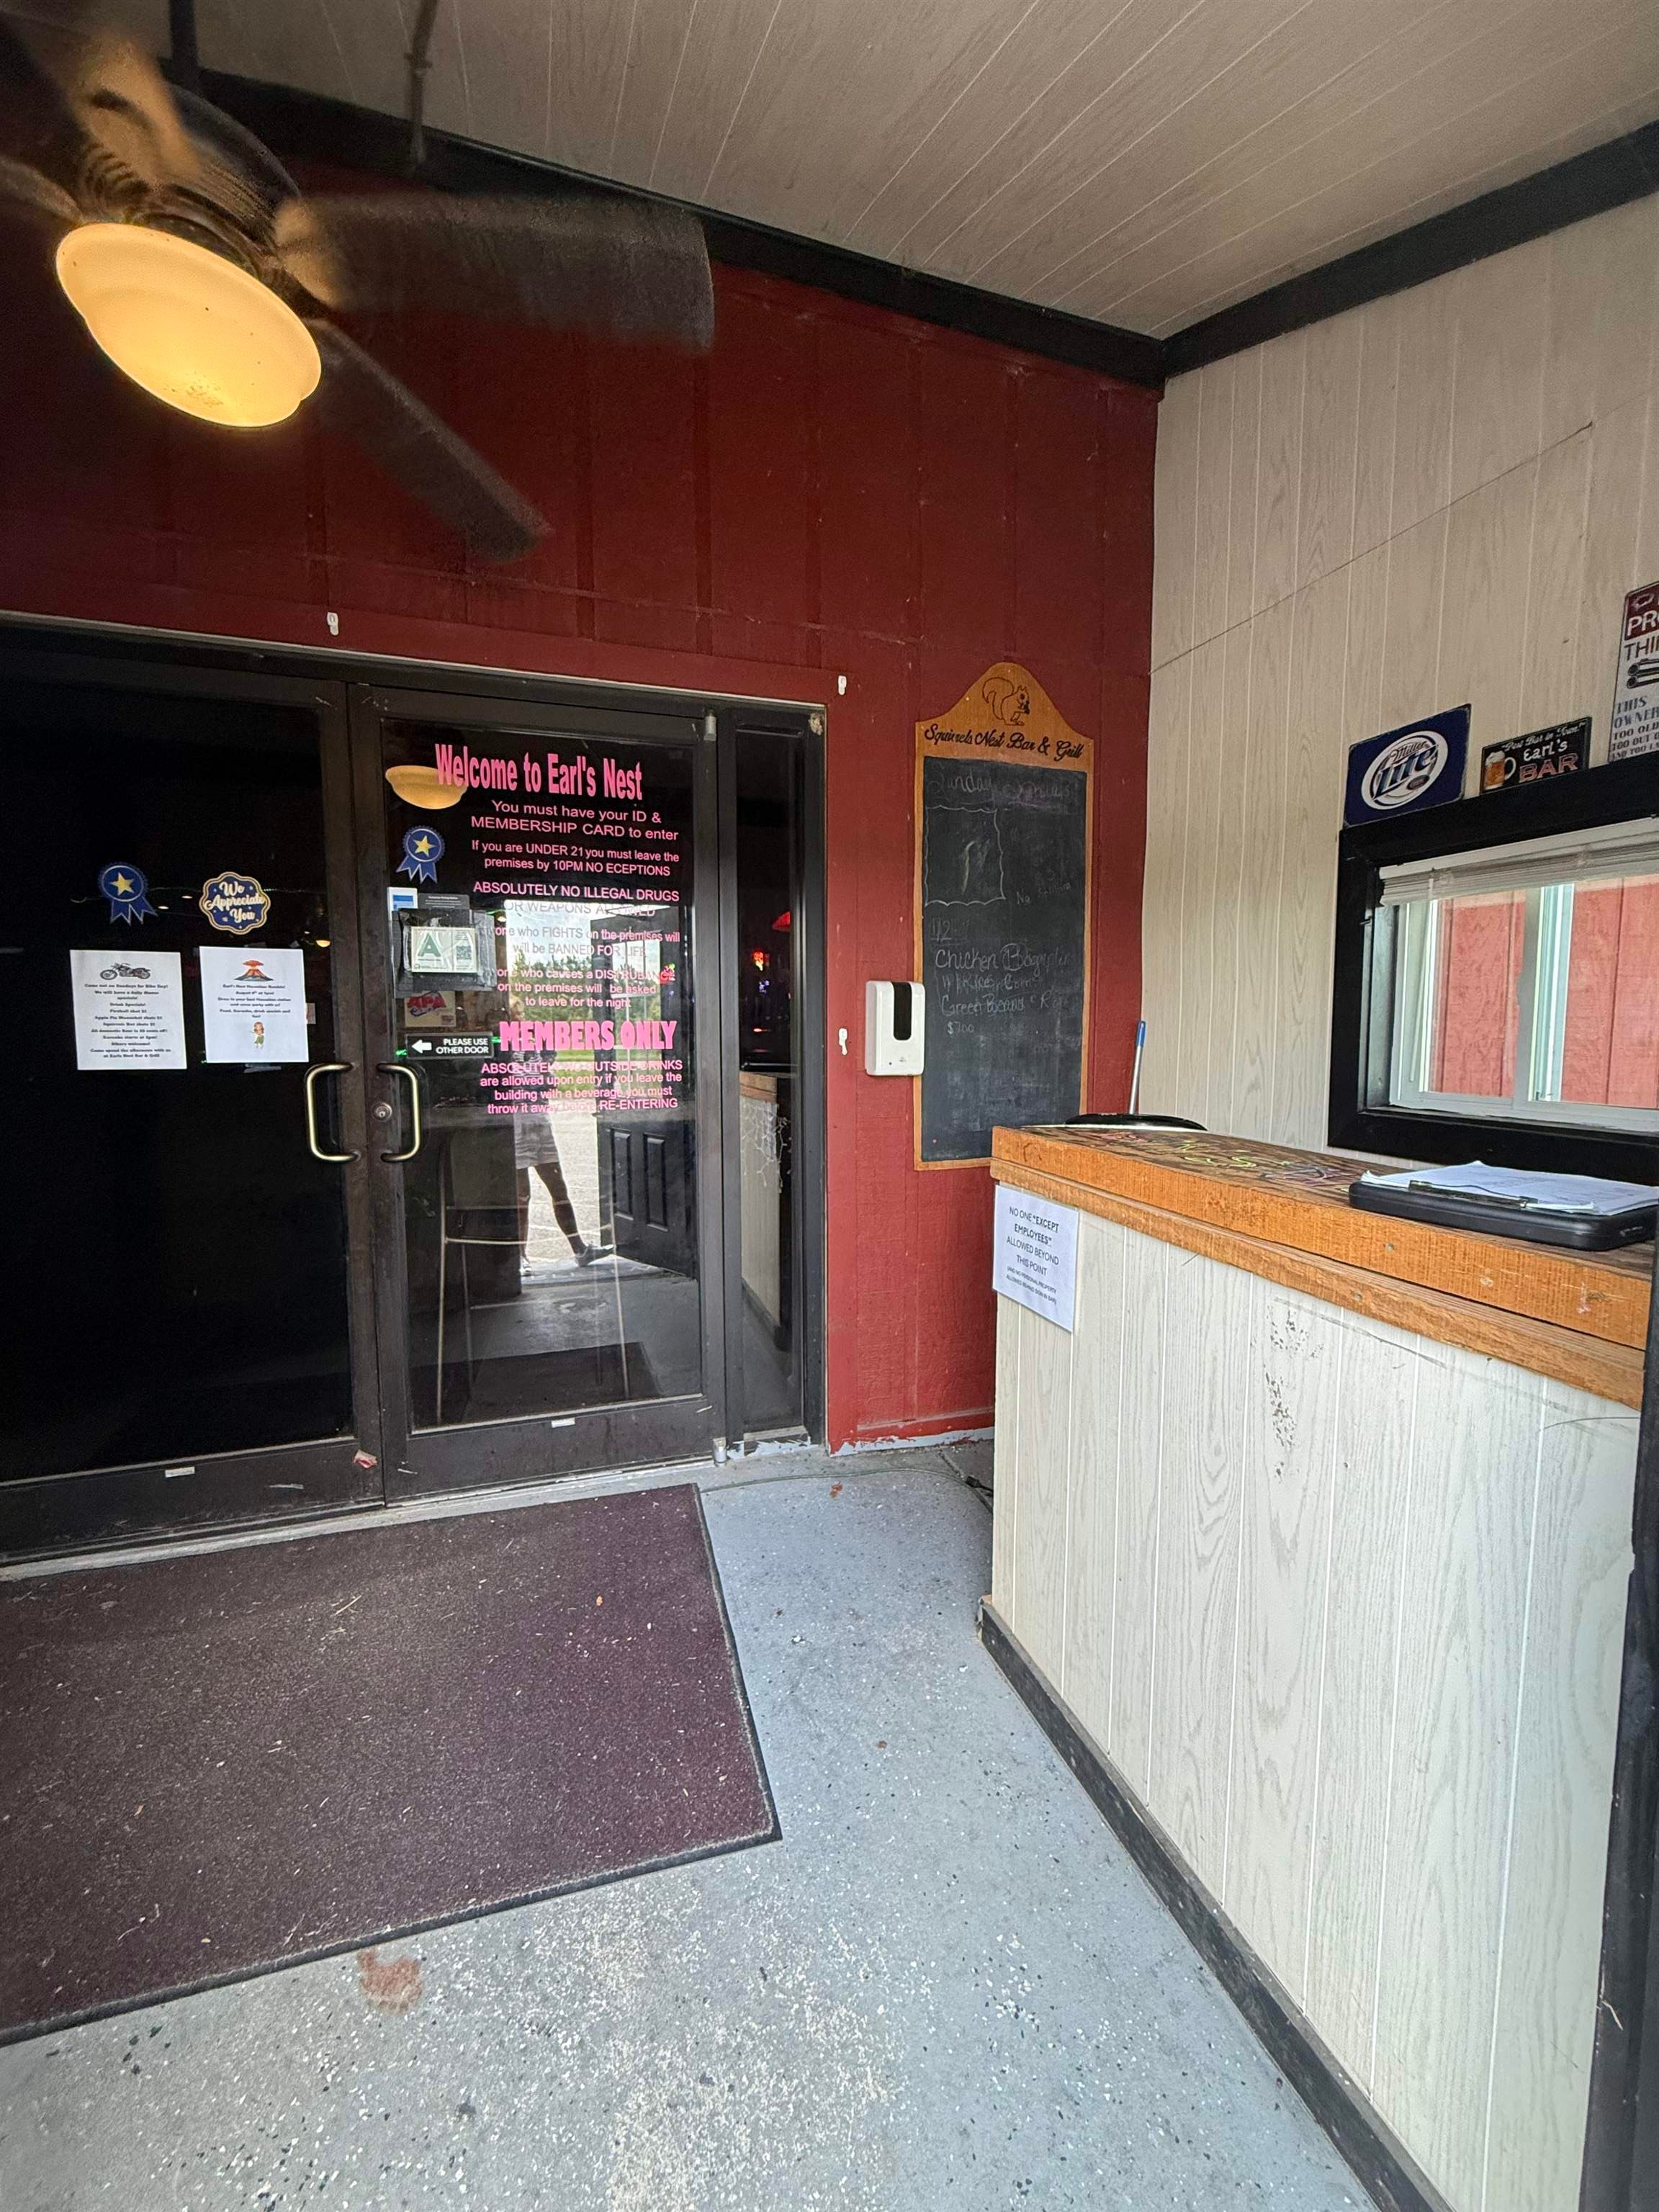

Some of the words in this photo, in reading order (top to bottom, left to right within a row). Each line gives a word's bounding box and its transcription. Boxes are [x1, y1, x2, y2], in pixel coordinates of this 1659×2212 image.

[1617, 696, 1648, 714] THIS
[925, 724, 973, 745] Squirrels
[975, 729, 1005, 748] Nest
[1007, 732, 1035, 750] Bar
[1038, 737, 1051, 755] &
[1053, 740, 1084, 762] Grill
[1612, 739, 1629, 751] TOO
[1632, 734, 1649, 745] OUT
[1614, 728, 1634, 740] TOO
[1390, 740, 1431, 762] Miller
[1630, 745, 1646, 755] TOO
[435, 743, 518, 791] Welcome
[523, 752, 541, 793] to
[548, 753, 596, 797] Earl's
[603, 758, 642, 800] Nest
[1374, 747, 1437, 799] Lite
[1519, 752, 1579, 783] BAR
[492, 799, 518, 813] You
[523, 805, 558, 816] must
[562, 805, 595, 819] have
[599, 809, 628, 822] your
[632, 811, 647, 822] ID
[652, 812, 662, 824] &
[471, 816, 577, 833] MEMBERSHIP
[583, 823, 625, 837] CARD
[629, 827, 642, 838] to
[645, 830, 679, 840] enter
[472, 840, 480, 850] If
[482, 842, 502, 853] you
[505, 844, 523, 853] are
[526, 843, 568, 855] UNDER
[571, 846, 583, 857] 21
[585, 848, 604, 859] you
[607, 850, 631, 859] must
[634, 850, 661, 861] leave
[663, 852, 680, 862] the
[484, 858, 534, 869] premises
[536, 859, 549, 872] by
[553, 860, 583, 872] 10PM
[586, 862, 603, 873] NO
[606, 863, 670, 876] ECEPTIONS
[219, 881, 245, 896] We
[473, 881, 558, 896] ABSOLUTELY
[561, 886, 580, 897] NO
[584, 886, 634, 899] ILLEGAL
[637, 889, 680, 901] DRUGS
[205, 892, 266, 911] Appreciate
[504, 901, 524, 912] OR
[527, 902, 591, 914] WEAPONS
[230, 908, 256, 923] You
[518, 925, 539, 936] who
[541, 927, 583, 938] FIGHTS
[588, 930, 598, 939] on
[601, 929, 616, 940] the
[619, 930, 663, 942] premises
[665, 932, 680, 943] will
[418, 932, 441, 957] A
[513, 943, 529, 953] will
[532, 943, 545, 954] be
[548, 944, 595, 955] BANNED
[597, 945, 621, 956] FOR
[935, 948, 999, 972] Chicken
[521, 968, 543, 978] who
[546, 970, 583, 979] causes
[498, 983, 511, 992] on
[515, 982, 531, 992] the
[534, 983, 583, 993] premises
[585, 984, 602, 993] will
[610, 984, 622, 994] be
[626, 984, 657, 994] asked
[526, 997, 536, 1006] to
[539, 997, 567, 1007] leave
[570, 997, 585, 1007] for
[587, 997, 603, 1007] the
[606, 998, 631, 1010] night
[942, 994, 981, 1017] Green
[499, 1020, 614, 1051] MEMBERS
[620, 1020, 677, 1050] ONLY
[641, 1059, 683, 1071] DRINKS
[480, 1078, 499, 1087] are
[502, 1075, 544, 1086] allowed
[547, 1076, 574, 1087] upon
[576, 1075, 603, 1086] entry
[606, 1073, 612, 1083] if
[614, 1075, 633, 1085] you
[636, 1073, 663, 1083] leave
[666, 1072, 682, 1082] the
[495, 1089, 538, 1102] building
[540, 1089, 562, 1099] with
[575, 1087, 624, 1099] beverage
[648, 1086, 673, 1096] must
[487, 1103, 518, 1114] throw
[521, 1103, 528, 1113] it
[599, 1098, 678, 1110] RE-ENTERING
[1010, 1206, 1018, 1217] NO
[1020, 1210, 1032, 1222] ONE
[1007, 1236, 1033, 1254] ALLOWED
[1035, 1247, 1059, 1265] BEYOND
[1017, 1254, 1029, 1268] THIS
[1030, 1261, 1047, 1276] POINT
[1022, 1272, 1038, 1285] PERSONAL
[1038, 1280, 1057, 1294] PROPERTY
